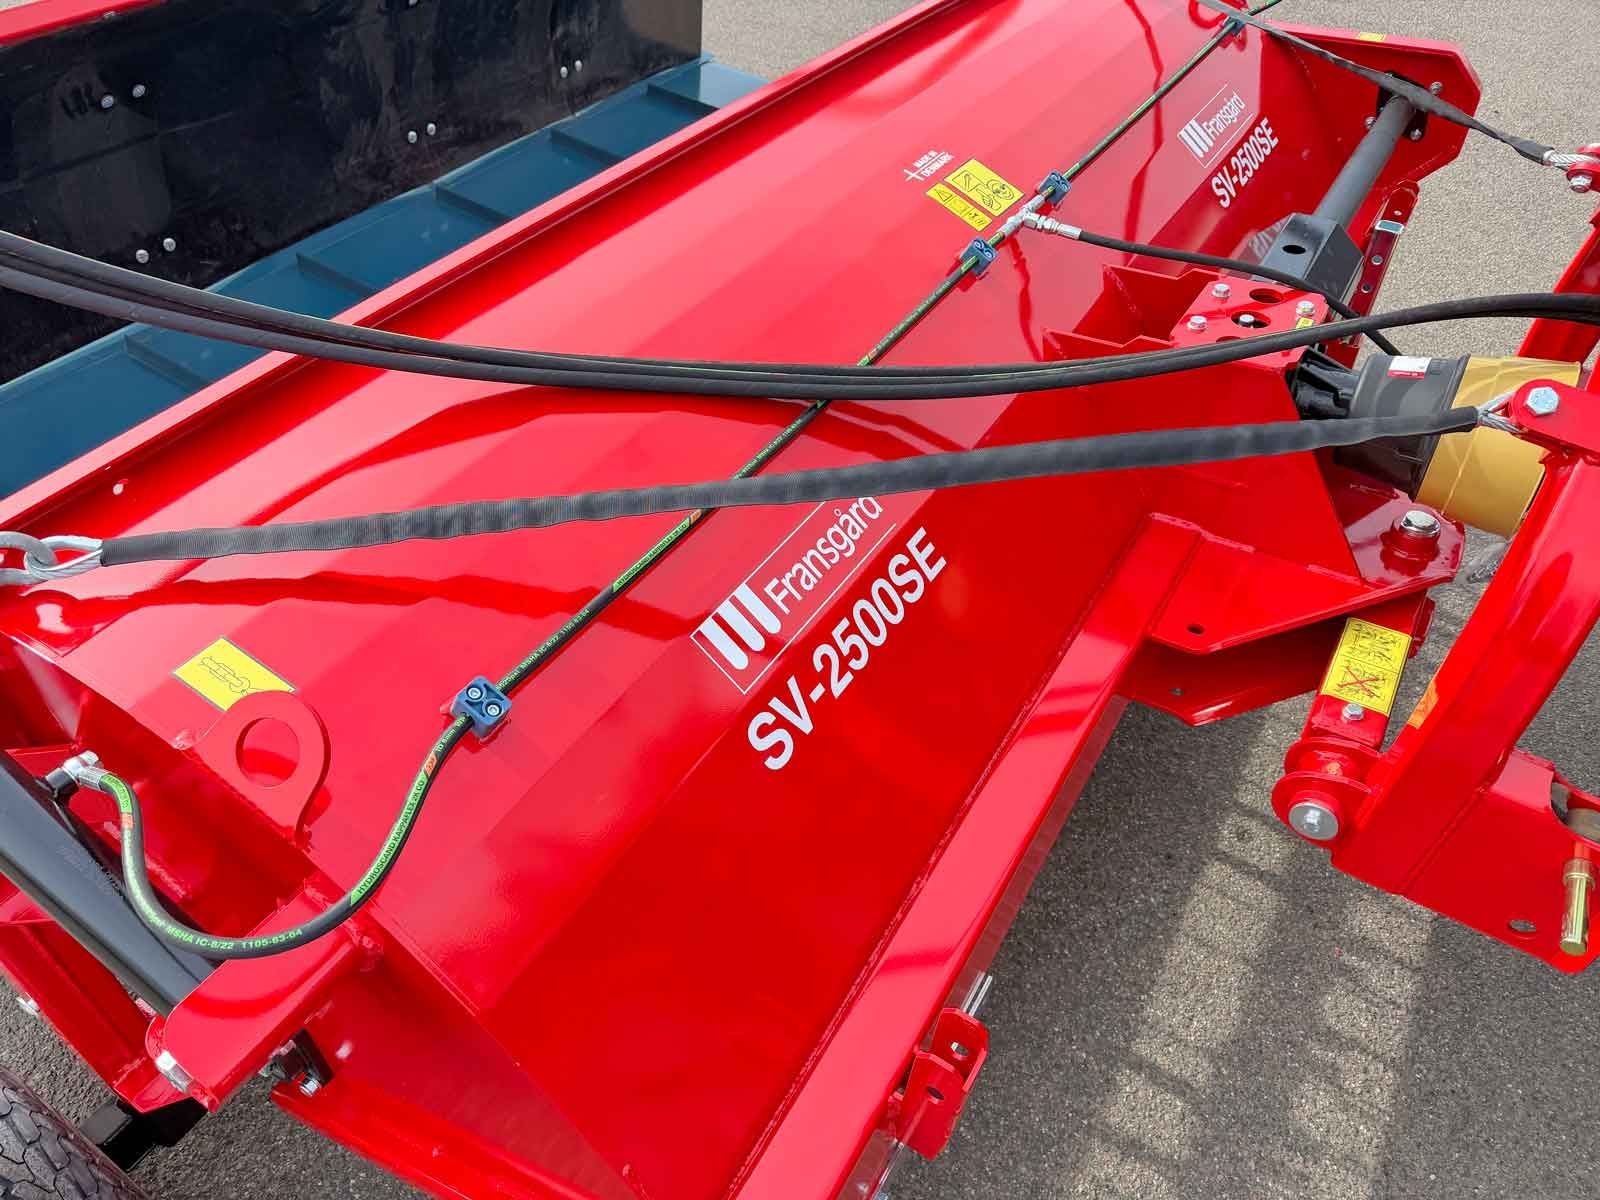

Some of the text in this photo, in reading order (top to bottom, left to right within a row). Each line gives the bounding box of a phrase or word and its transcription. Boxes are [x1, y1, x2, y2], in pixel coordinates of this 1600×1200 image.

[1211, 117, 1279, 208] SV-2500SE
[763, 496, 884, 615] Fransgård
[747, 527, 947, 770] SV-2500SE
[357, 841, 397, 894] HYDROSCAND
[167, 926, 194, 944] MSHA
